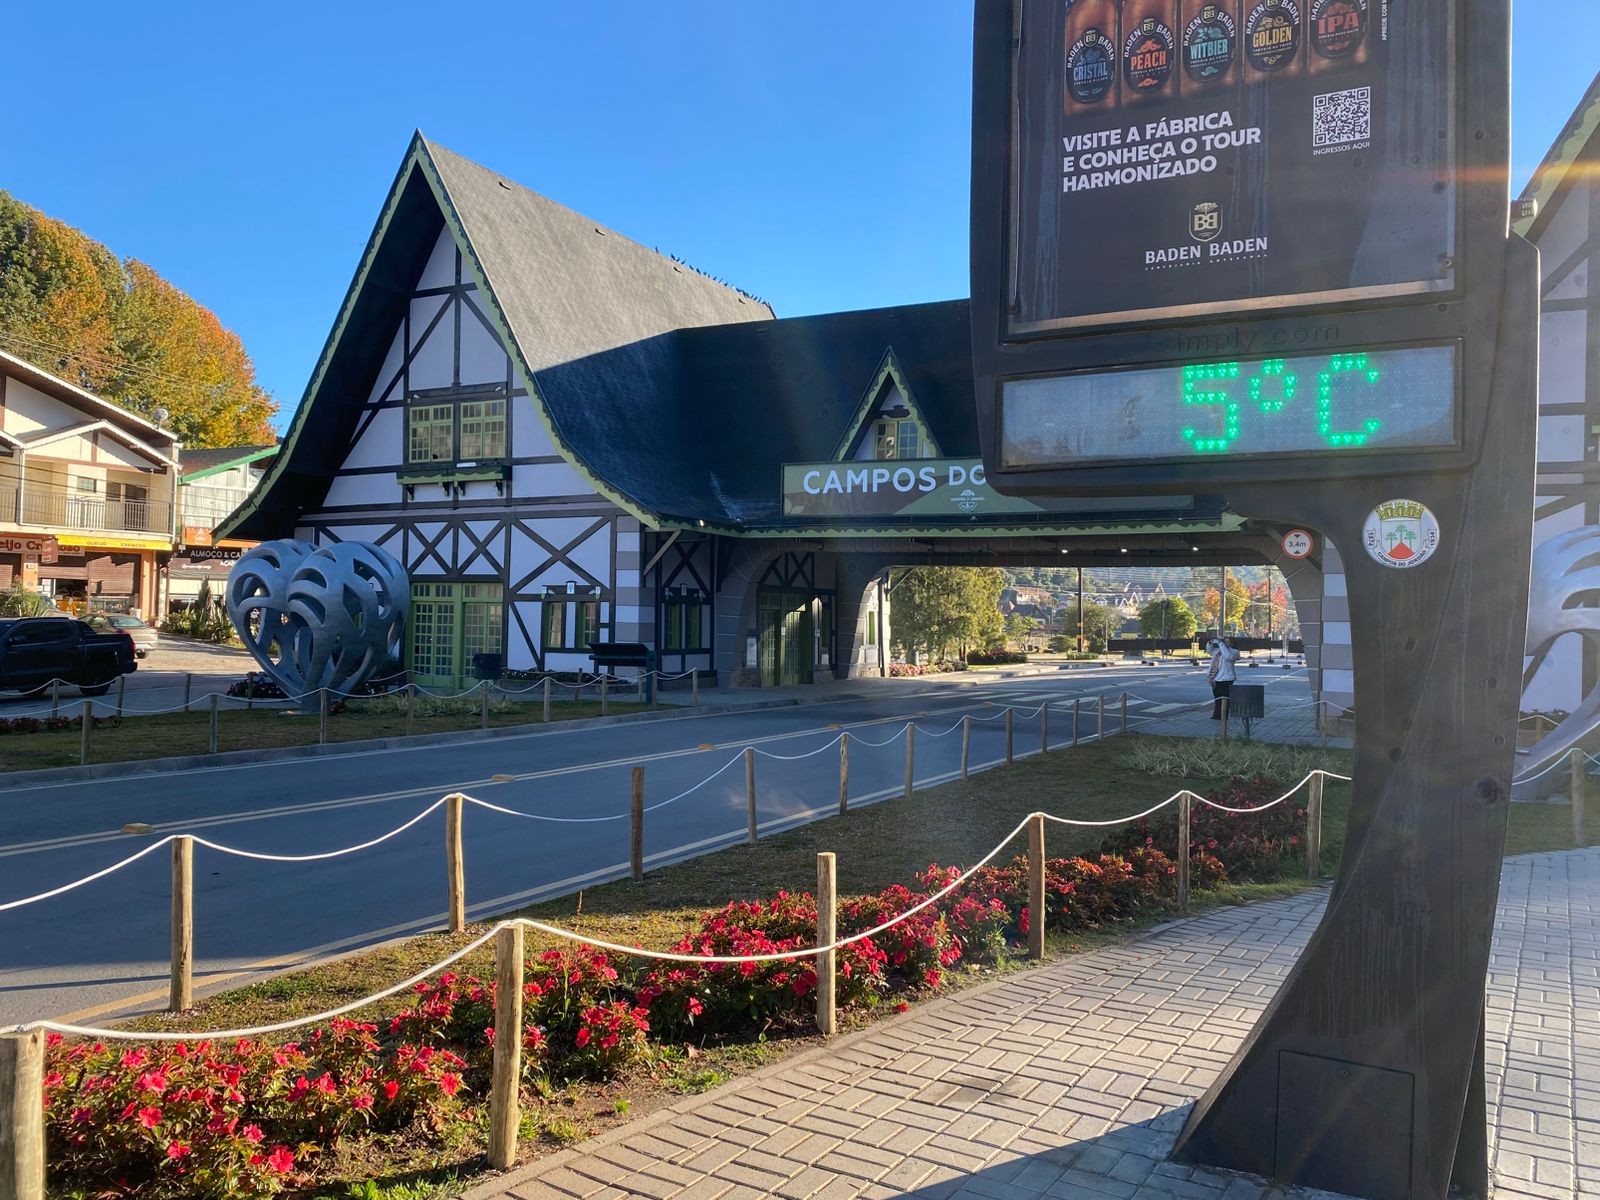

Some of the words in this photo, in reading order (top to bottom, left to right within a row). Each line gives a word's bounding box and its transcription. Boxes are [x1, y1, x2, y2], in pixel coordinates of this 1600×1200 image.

[1183, 17, 1202, 47] BADEN
[1217, 11, 1236, 38] BADEN
[1246, 4, 1266, 35] BADEN
[1280, 0, 1300, 25] BADEN
[1318, 12, 1359, 35] IPA
[1124, 28, 1142, 58] BADEN
[1156, 24, 1174, 50] BADEN
[1190, 39, 1229, 60] WITBIER
[1253, 26, 1292, 48] GOLDEN
[1067, 40, 1085, 69] BADEN
[1098, 36, 1116, 61] BADEN
[1130, 50, 1167, 71] PEACH
[1073, 62, 1108, 82] CRISTAL
[1063, 126, 1122, 153] VISITE
[1126, 126, 1141, 142] A
[1145, 110, 1234, 140] FÁBRICA
[1063, 157, 1075, 173] E
[1079, 140, 1176, 171] CONHEÇA
[1180, 138, 1197, 154] O
[1202, 127, 1262, 152] TOUR
[1313, 145, 1352, 157] INGRESSOS
[1352, 141, 1371, 151] AQUI
[1062, 155, 1218, 193] HARMONIZADO
[1145, 244, 1202, 265] BADEN
[1209, 236, 1269, 257] BADEN
[803, 466, 936, 494] CAMPOS
[26, 541, 81, 552] Croso
[190, 550, 222, 558] ALMOÇO
[1377, 551, 1397, 566] CAMPOS
[1407, 550, 1427, 566] JORDÃO
